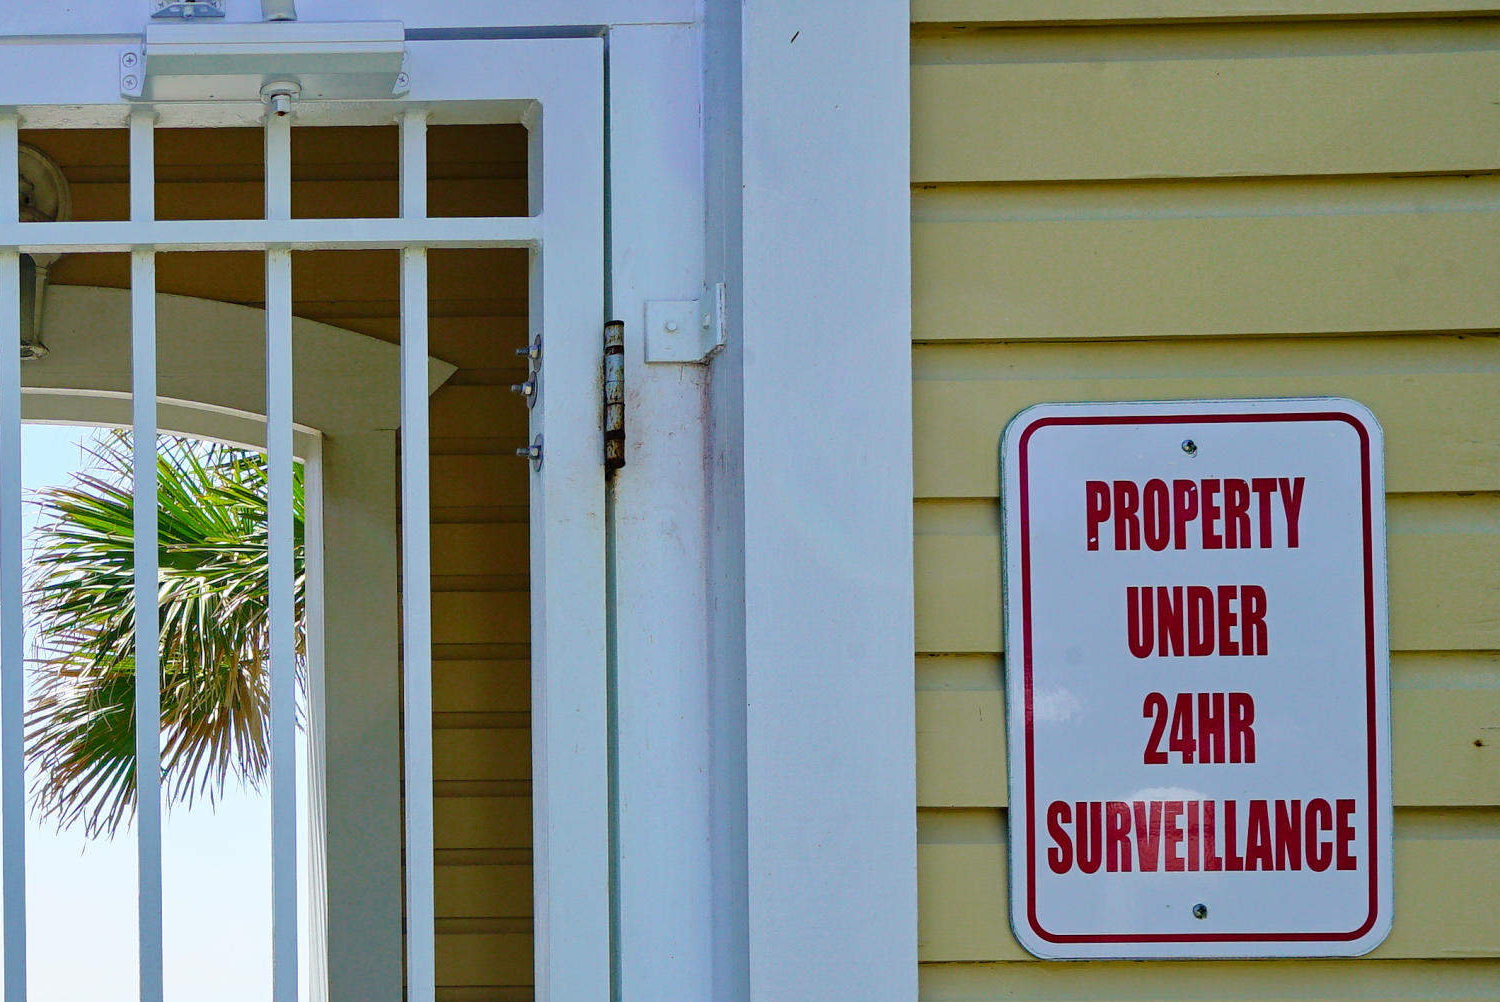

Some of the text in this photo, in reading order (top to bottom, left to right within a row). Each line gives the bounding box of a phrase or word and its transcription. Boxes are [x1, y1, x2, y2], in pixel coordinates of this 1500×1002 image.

[1086, 477, 1305, 551] PROPERTY
[1127, 585, 1268, 658] UNDER
[1143, 692, 1255, 764] 24HR
[1047, 798, 1357, 874] SURVEILLANCE
